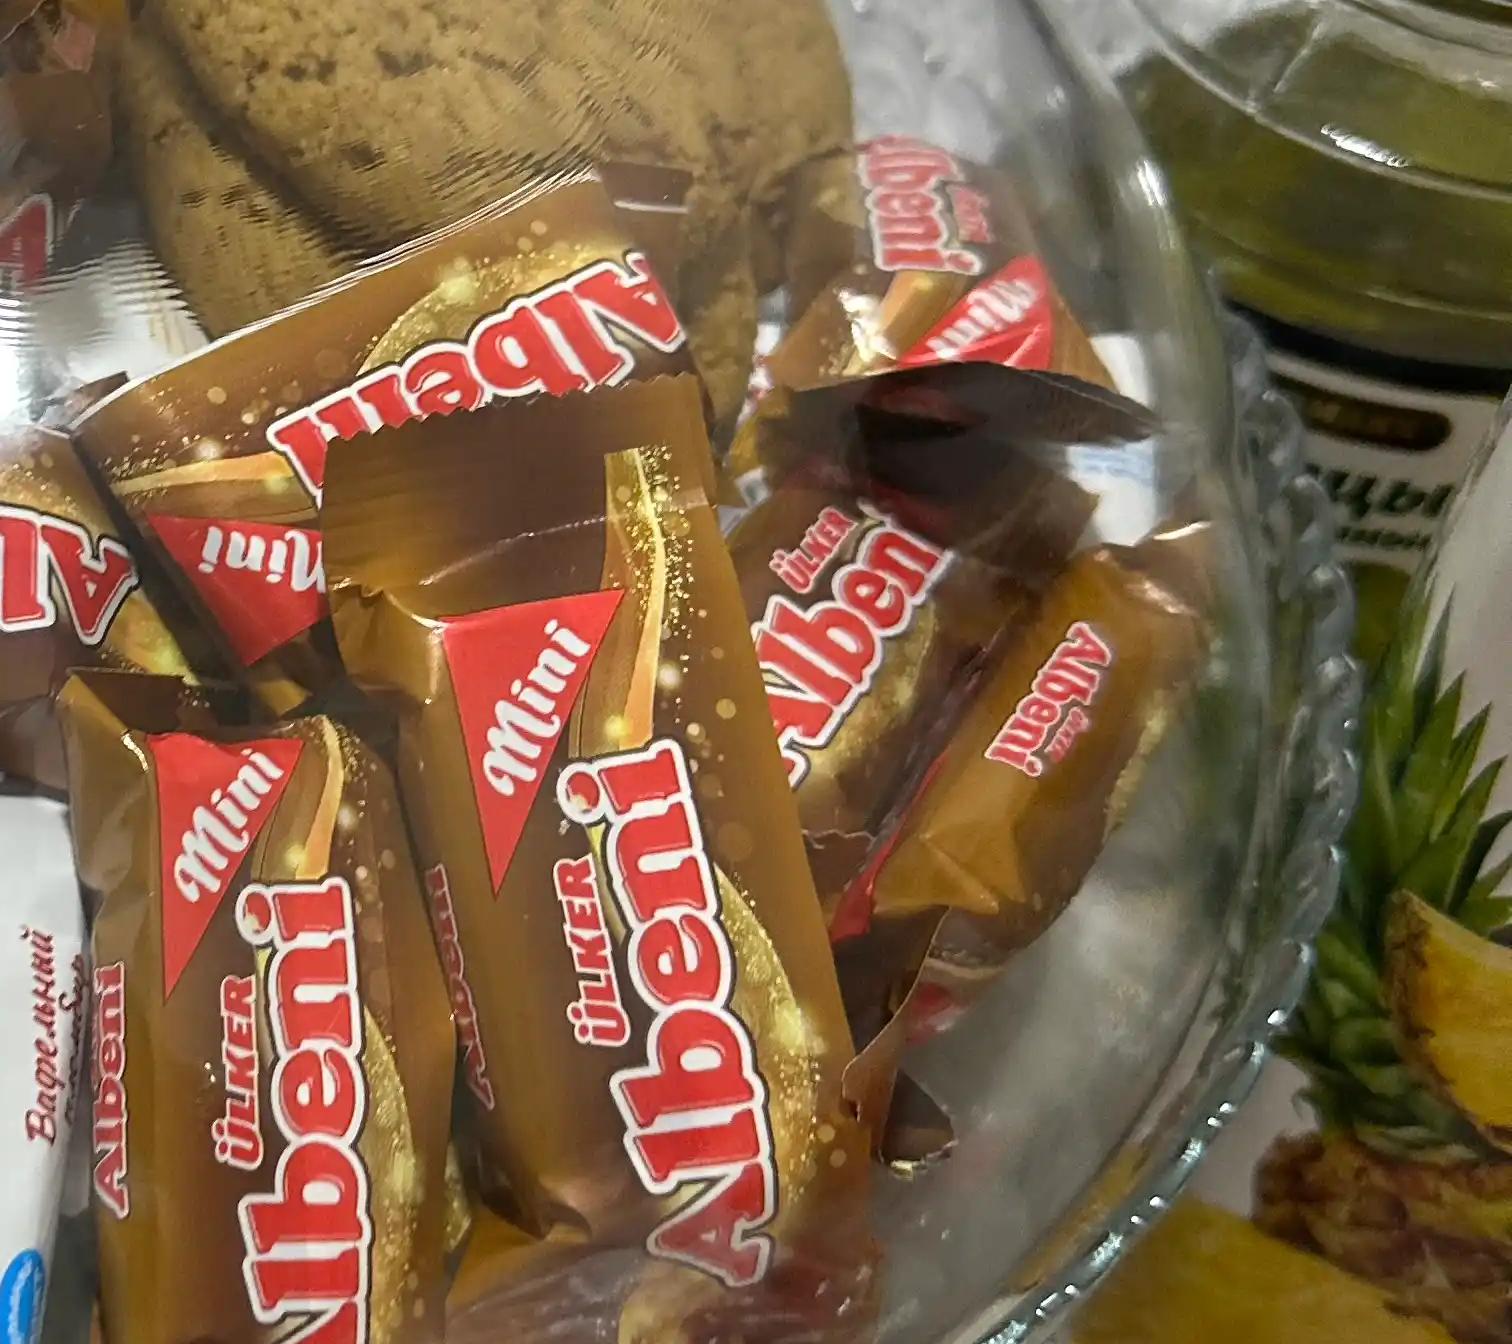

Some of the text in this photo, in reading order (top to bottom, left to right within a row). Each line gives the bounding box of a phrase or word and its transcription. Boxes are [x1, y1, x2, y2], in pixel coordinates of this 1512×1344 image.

[855, 133, 983, 276] lbeni
[769, 506, 859, 594] ÜLKER
[482, 617, 592, 799] Mini
[984, 621, 1112, 777] Albeni
[174, 747, 286, 905] Mini
[19, 923, 65, 1147] Вафельный
[553, 851, 633, 1048] ÜLKER
[558, 738, 778, 1287] Albeni
[93, 960, 129, 1219] Albeni
[210, 974, 264, 1172] ÜLKER
